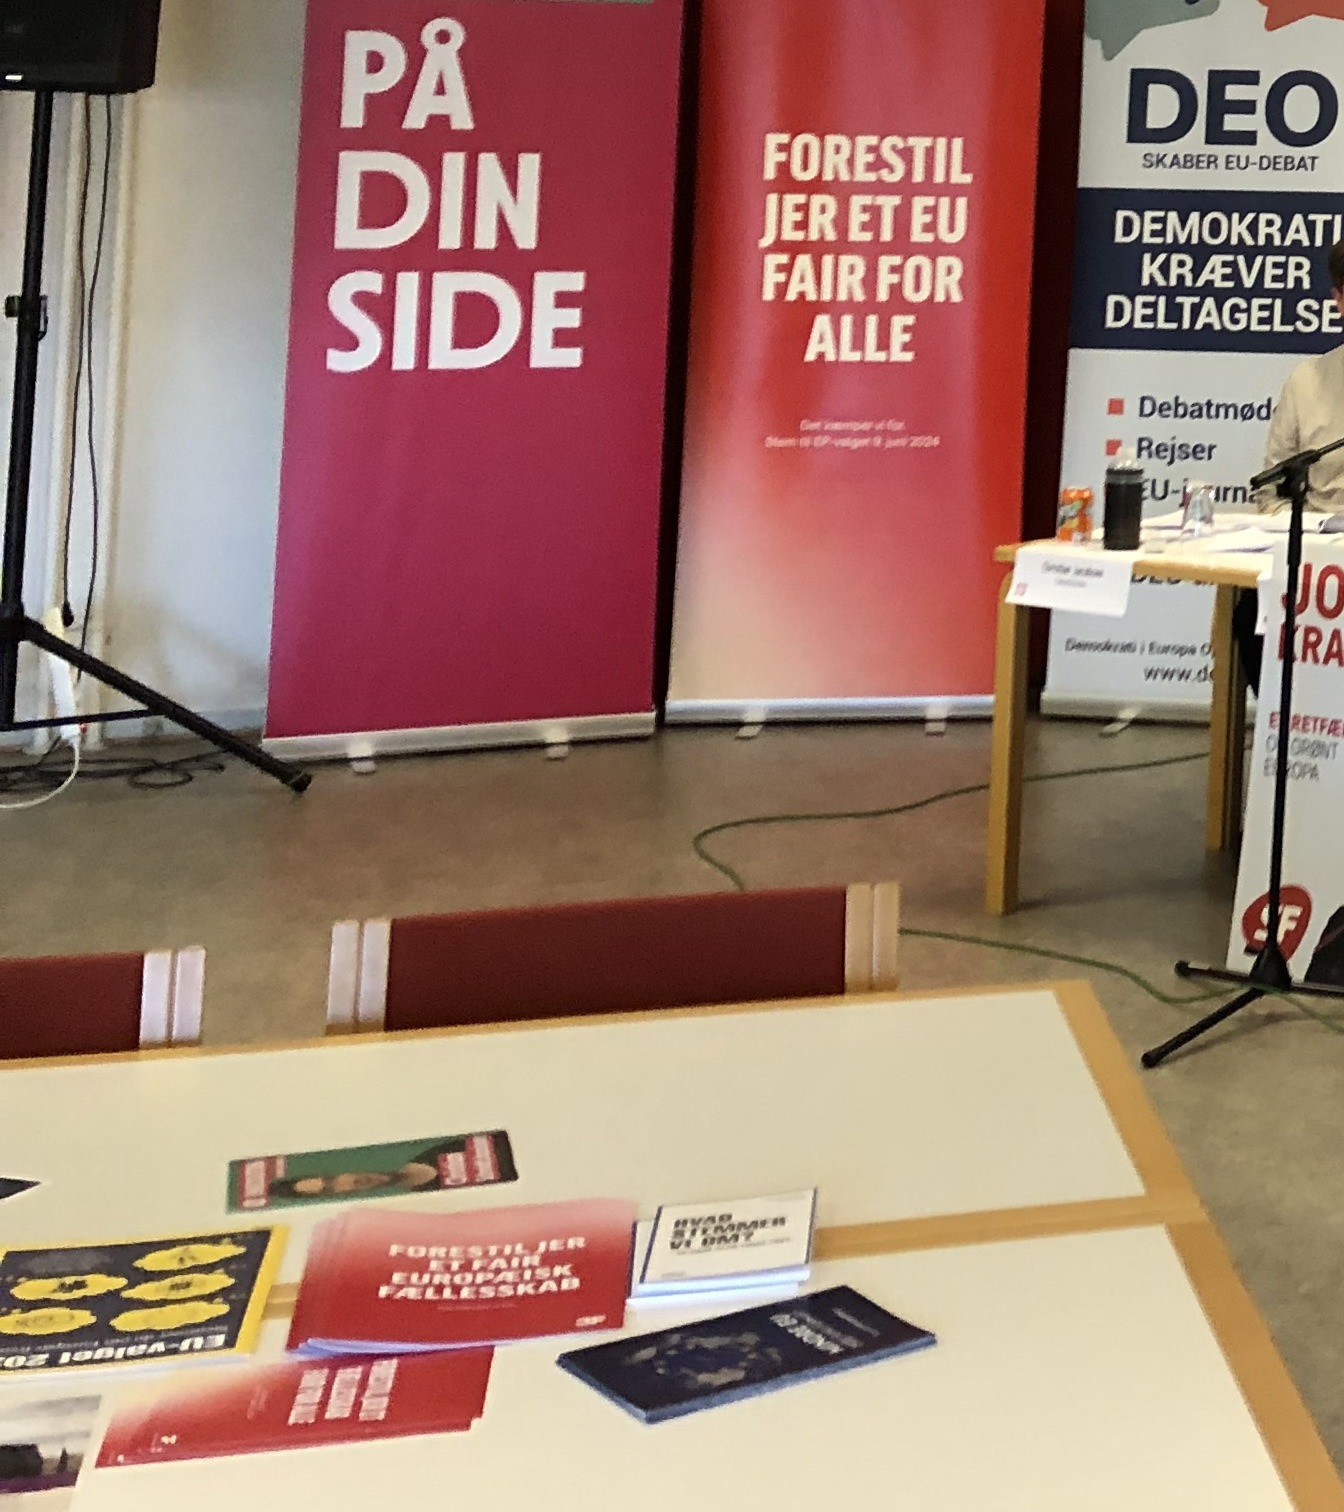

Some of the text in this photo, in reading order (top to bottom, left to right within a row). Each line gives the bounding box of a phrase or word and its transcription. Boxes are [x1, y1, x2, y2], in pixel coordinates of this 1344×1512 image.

[340, 17, 474, 130] PÅ
[1126, 67, 1339, 147] DEO
[763, 133, 973, 184] FORESTIL
[1142, 153, 1319, 173] SKABER EU-DEBAT
[334, 150, 541, 250] DIN
[758, 193, 968, 248] JER ET EU
[1114, 209, 1342, 247] DEMOKRATI
[762, 253, 964, 303] FAIR FOR
[1141, 252, 1311, 291] KRÆVER
[326, 270, 585, 372] SIDE
[1105, 294, 1343, 334] DELTAGELSE
[803, 314, 916, 362] ALLE
[1139, 395, 1276, 421] Debatmød
[1137, 436, 1217, 466] Rejser
[1065, 637, 1137, 653] Demokrati
[1144, 665, 1213, 682] www.d
[388, 1237, 586, 1259] FORESTIL JER
[427, 1254, 543, 1272] ET FAIR
[378, 1277, 581, 1300] FÆLLESSKAB
[391, 1264, 573, 1286] EUROPÆISK
[58, 1333, 227, 1365] EU-valget
